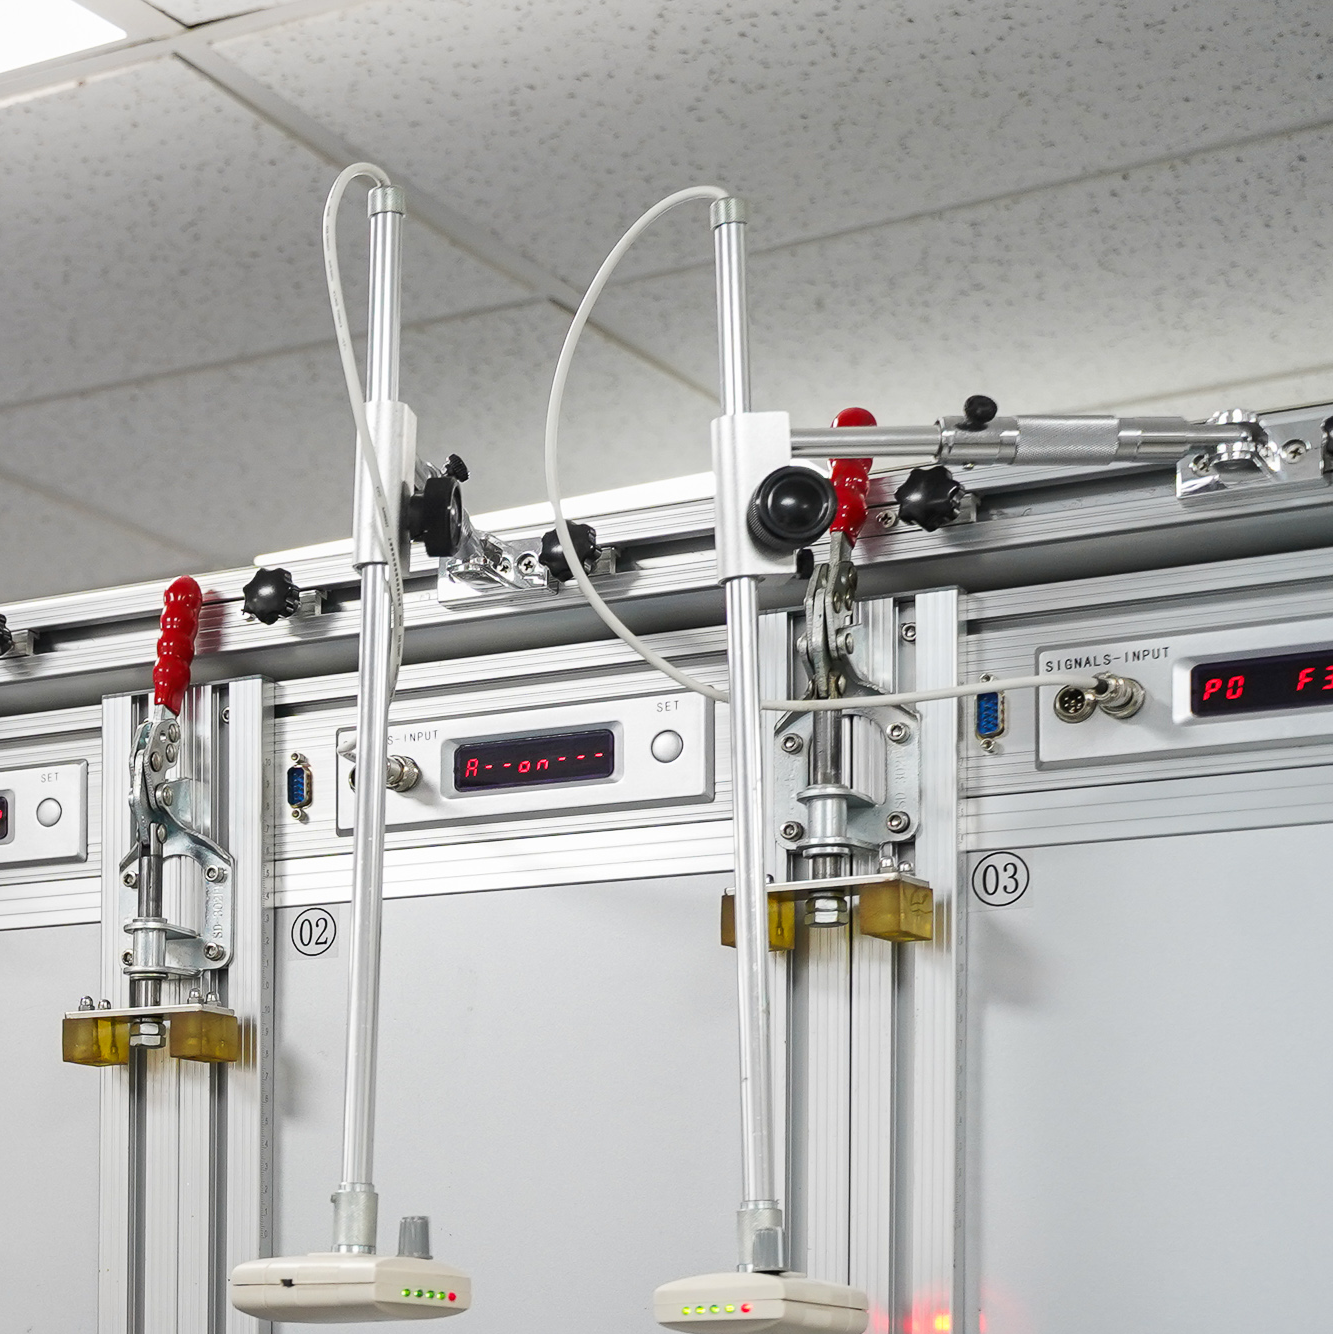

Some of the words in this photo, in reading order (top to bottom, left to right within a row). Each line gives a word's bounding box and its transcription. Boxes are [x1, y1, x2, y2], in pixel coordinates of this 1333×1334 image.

[1045, 647, 1171, 673] SIGNALS-INPUT
[656, 700, 680, 712] SET
[41, 771, 60, 783] SET
[982, 864, 1019, 896] 03
[299, 917, 329, 946] 02
